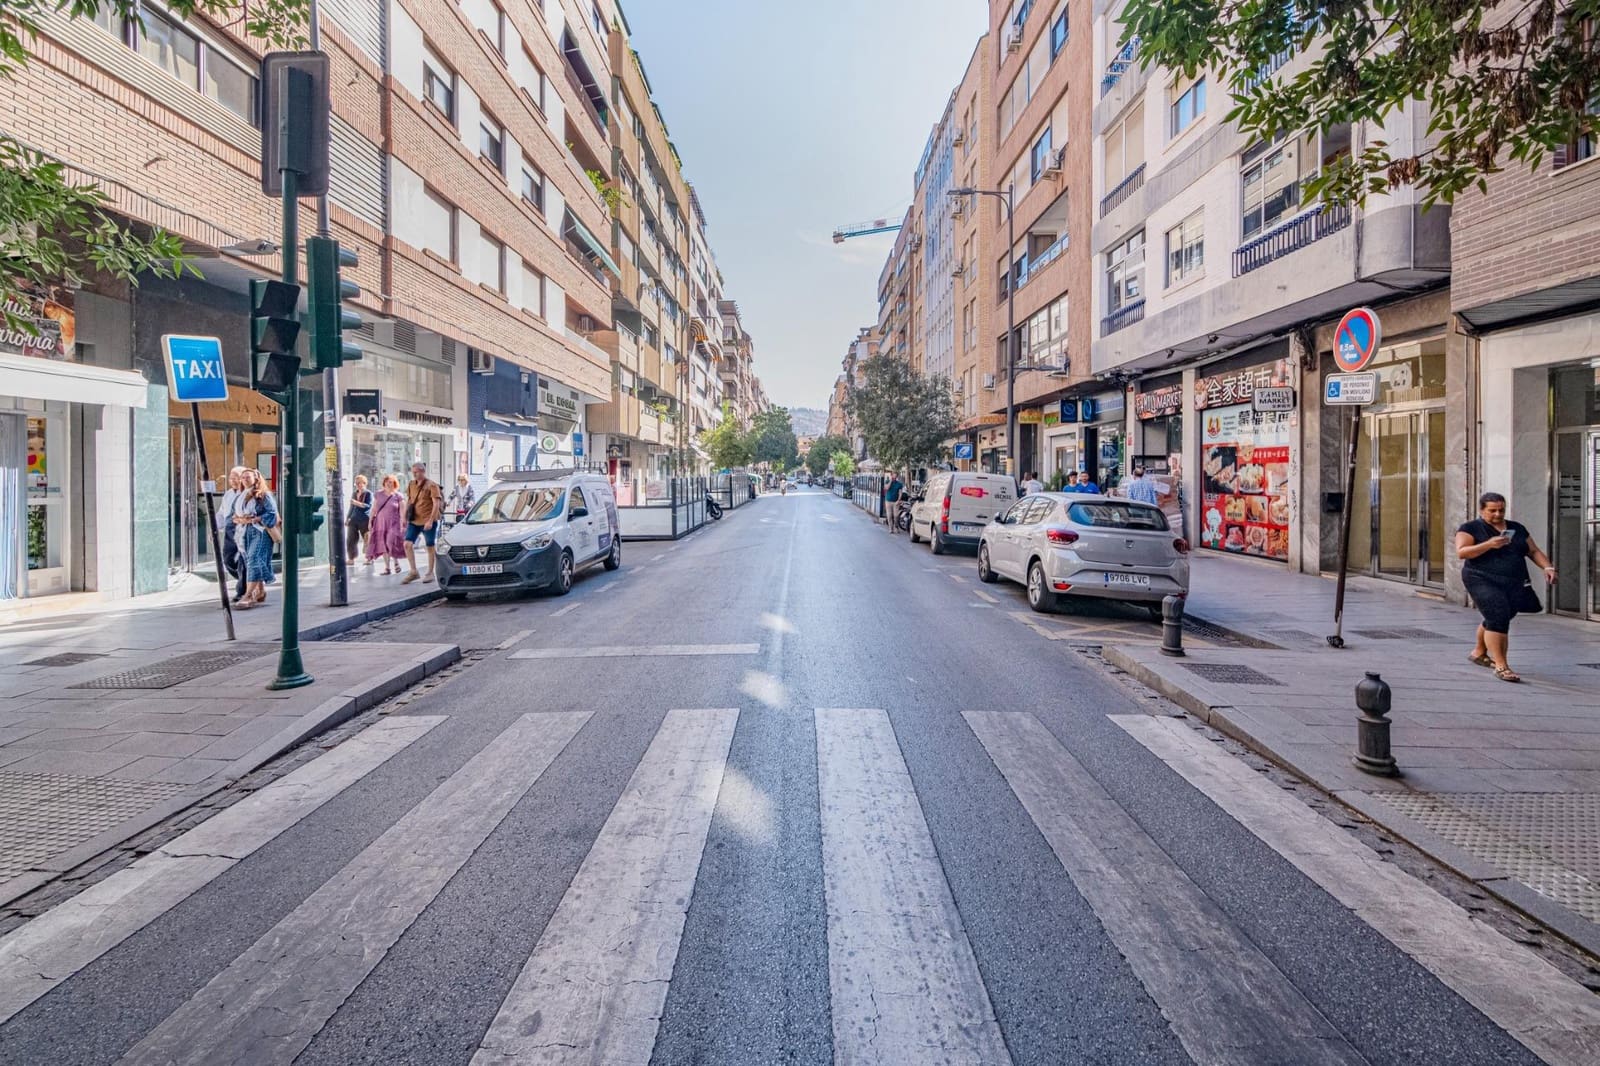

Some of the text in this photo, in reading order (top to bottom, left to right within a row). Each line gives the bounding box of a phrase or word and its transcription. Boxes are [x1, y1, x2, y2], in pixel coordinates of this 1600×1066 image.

[174, 359, 222, 379] TAXI
[266, 404, 277, 416] 24
[1109, 573, 1148, 584] 9706 LVC
